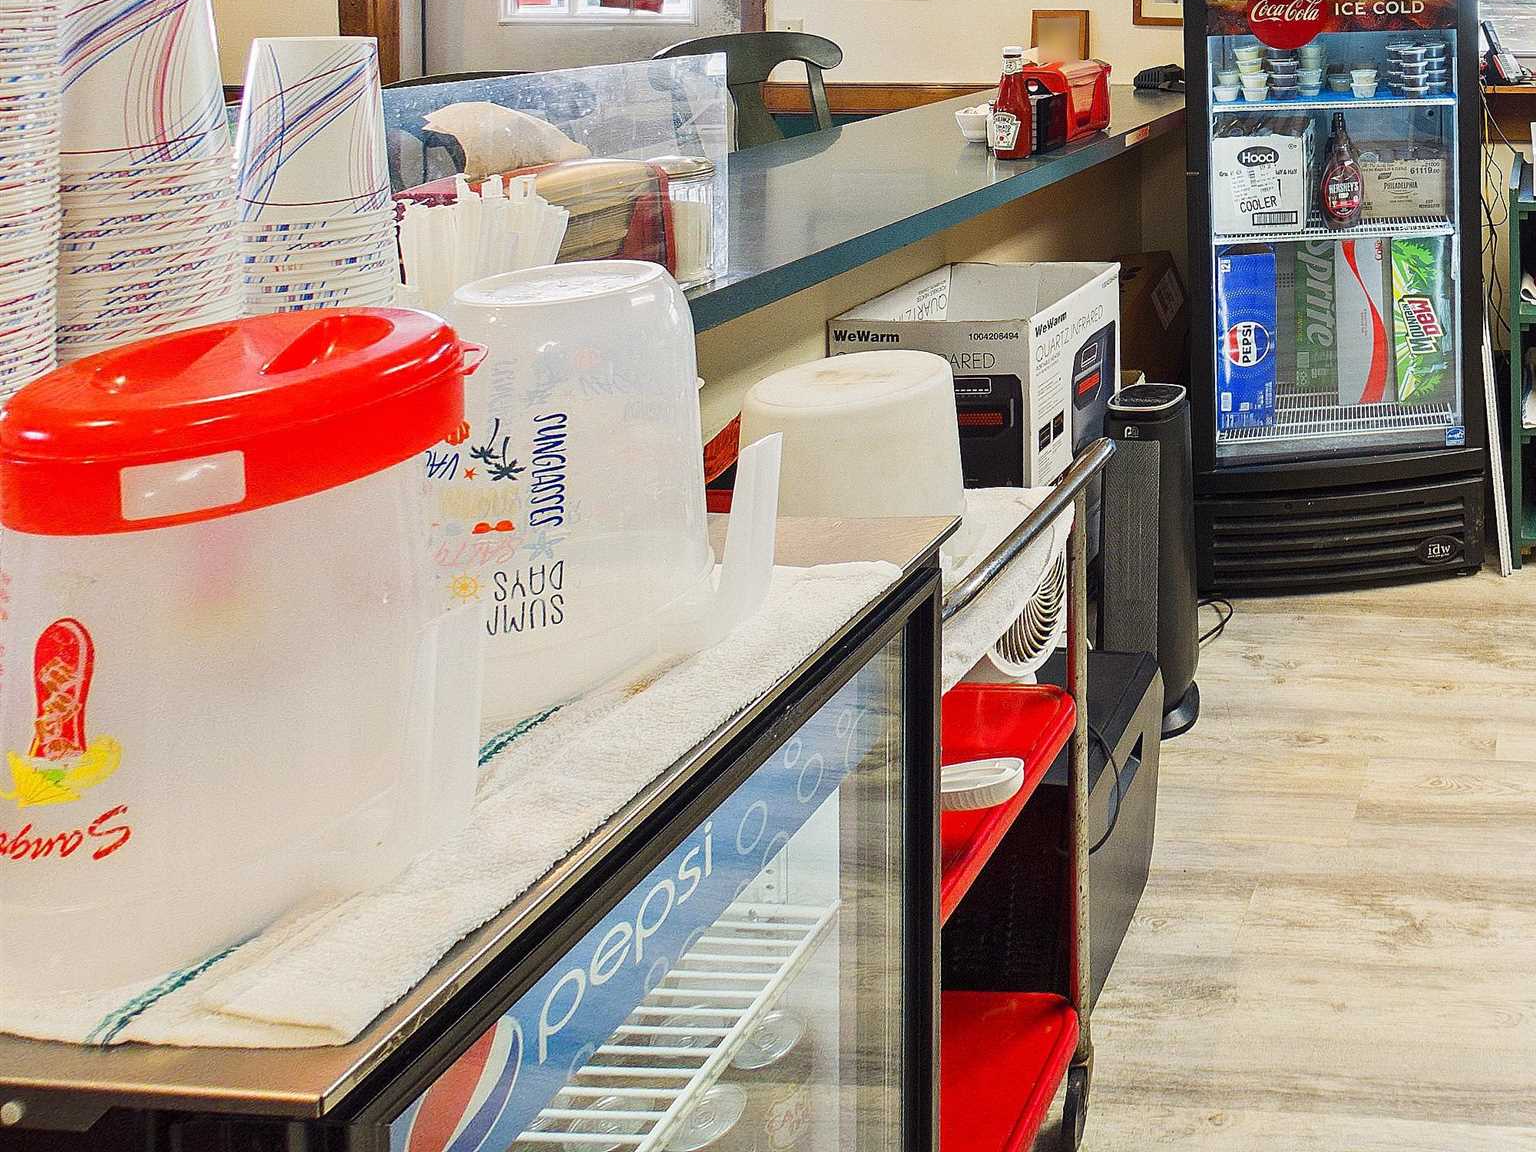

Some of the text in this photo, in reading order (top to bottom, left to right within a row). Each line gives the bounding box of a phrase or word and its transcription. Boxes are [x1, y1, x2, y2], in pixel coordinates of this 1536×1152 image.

[1335, 0, 1424, 16] ICE COLD
[1242, 151, 1275, 164] Hood
[1328, 182, 1359, 194] HERSHEY'S
[1240, 195, 1278, 213] COOLER
[833, 330, 900, 343] WeWarm
[1035, 312, 1068, 338] WeWarm
[1035, 304, 1104, 363] QUARTZ INFRARED
[1242, 325, 1252, 363] PEPSI
[530, 413, 567, 528] SUNGLASSES
[1428, 543, 1451, 555] idw
[493, 560, 564, 602] DAYS
[0, 804, 131, 861] Sangr
[537, 821, 714, 1065] pepsi
